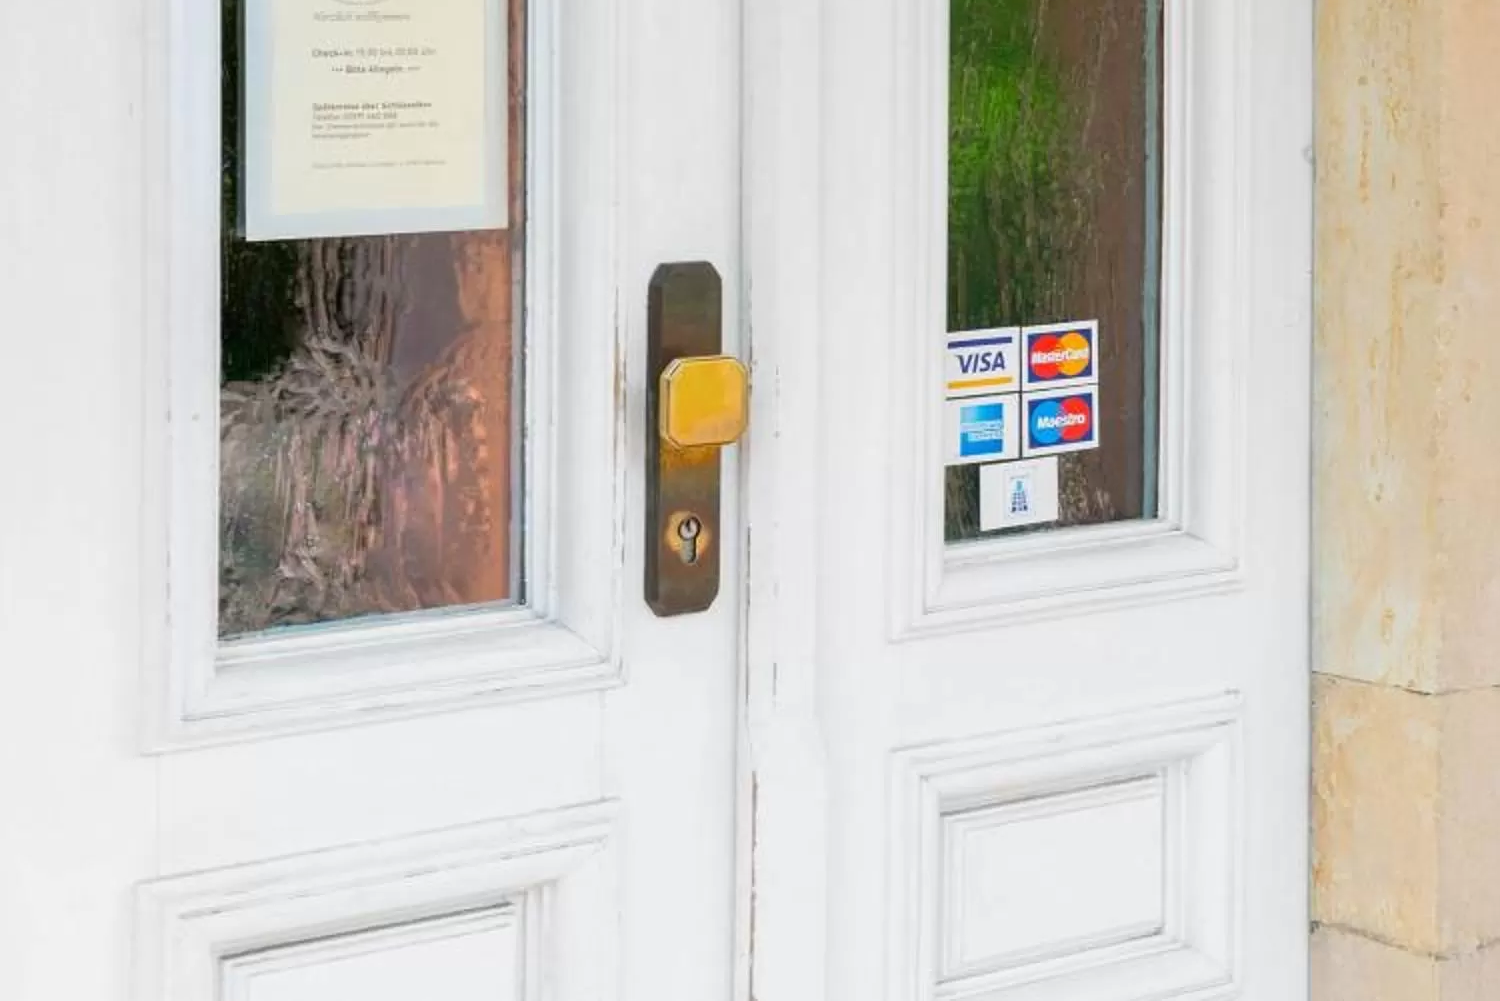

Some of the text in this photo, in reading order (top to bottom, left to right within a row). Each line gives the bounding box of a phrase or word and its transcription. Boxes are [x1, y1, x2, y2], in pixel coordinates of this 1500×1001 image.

[957, 350, 1006, 375] VISA
[1031, 347, 1089, 365] MasterCard
[1037, 412, 1086, 430] Maestro
